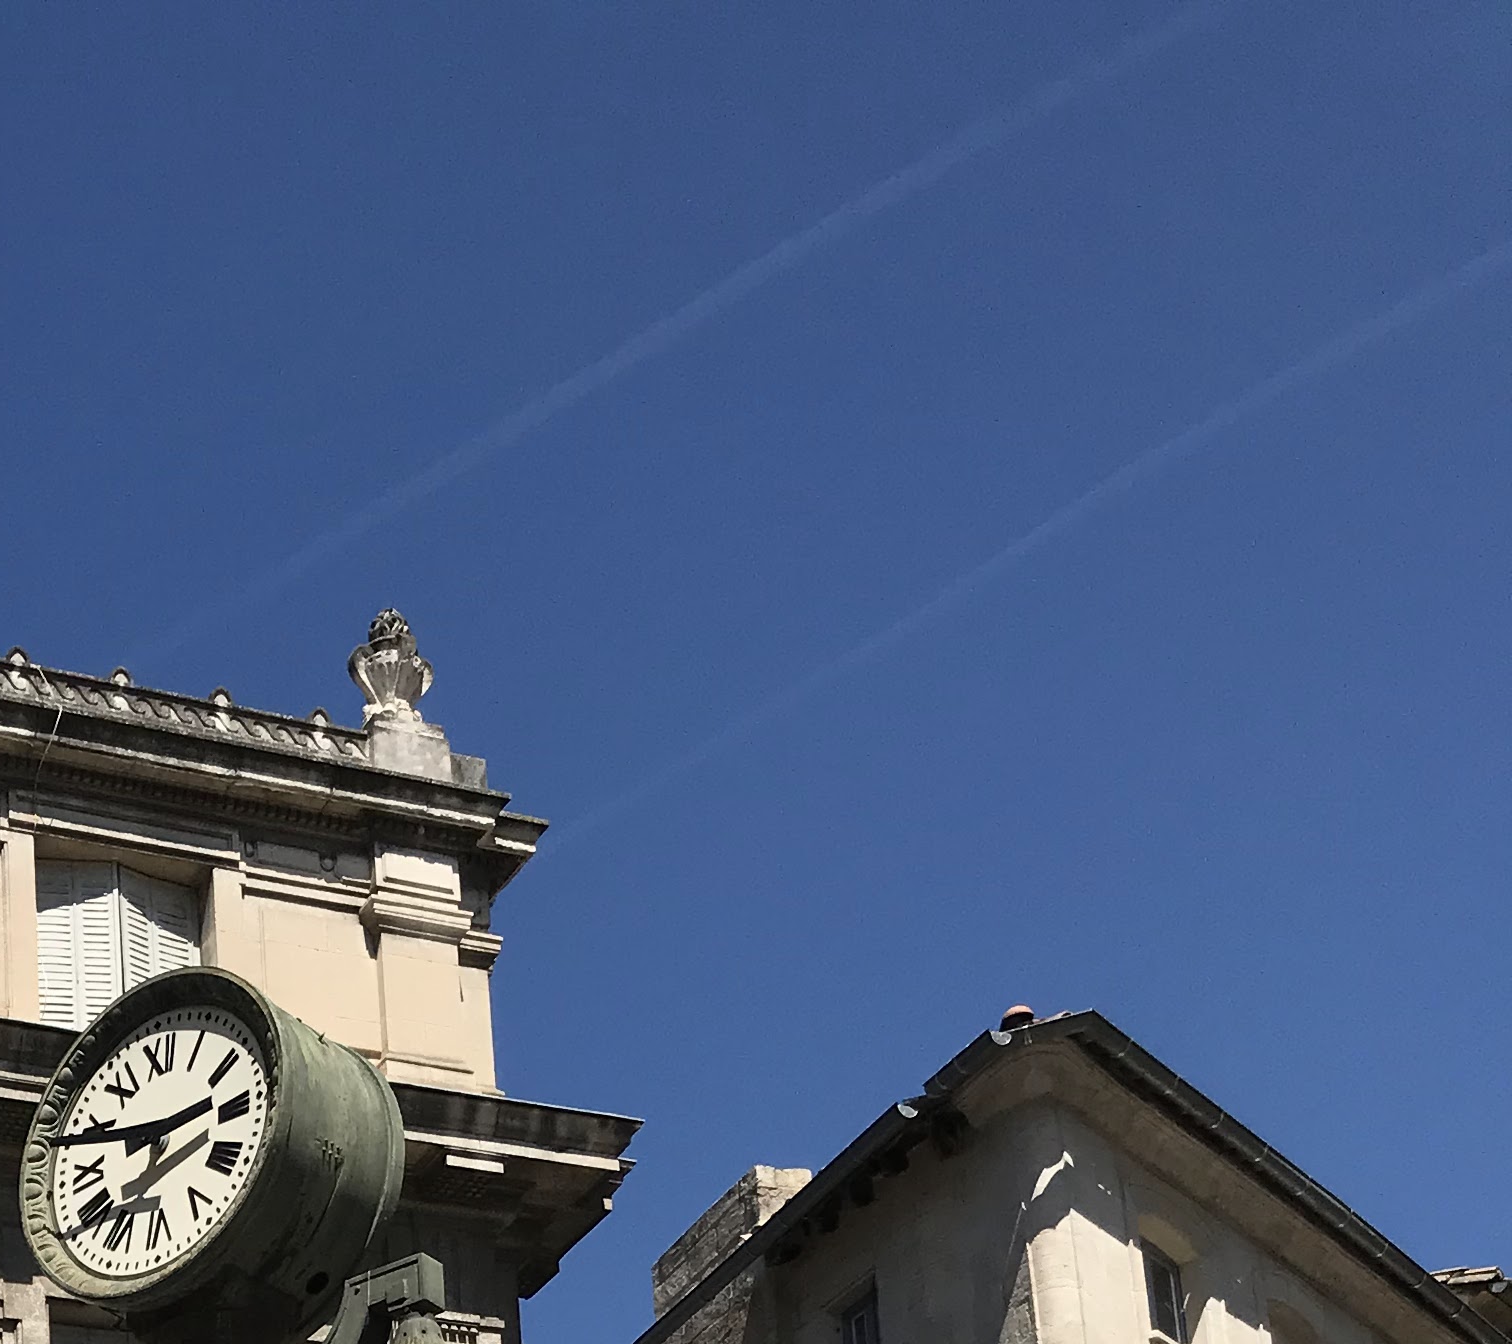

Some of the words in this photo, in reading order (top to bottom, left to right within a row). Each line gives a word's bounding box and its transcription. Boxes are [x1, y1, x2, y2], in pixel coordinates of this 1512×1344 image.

[143, 1032, 176, 1082] XII
[208, 1048, 239, 1089] II
[104, 1062, 140, 1109] XI
[218, 1089, 250, 1125] III
[73, 1154, 105, 1195] IX
[188, 1186, 213, 1222] V
[104, 1209, 135, 1254] VII
[146, 1208, 171, 1251] VI
